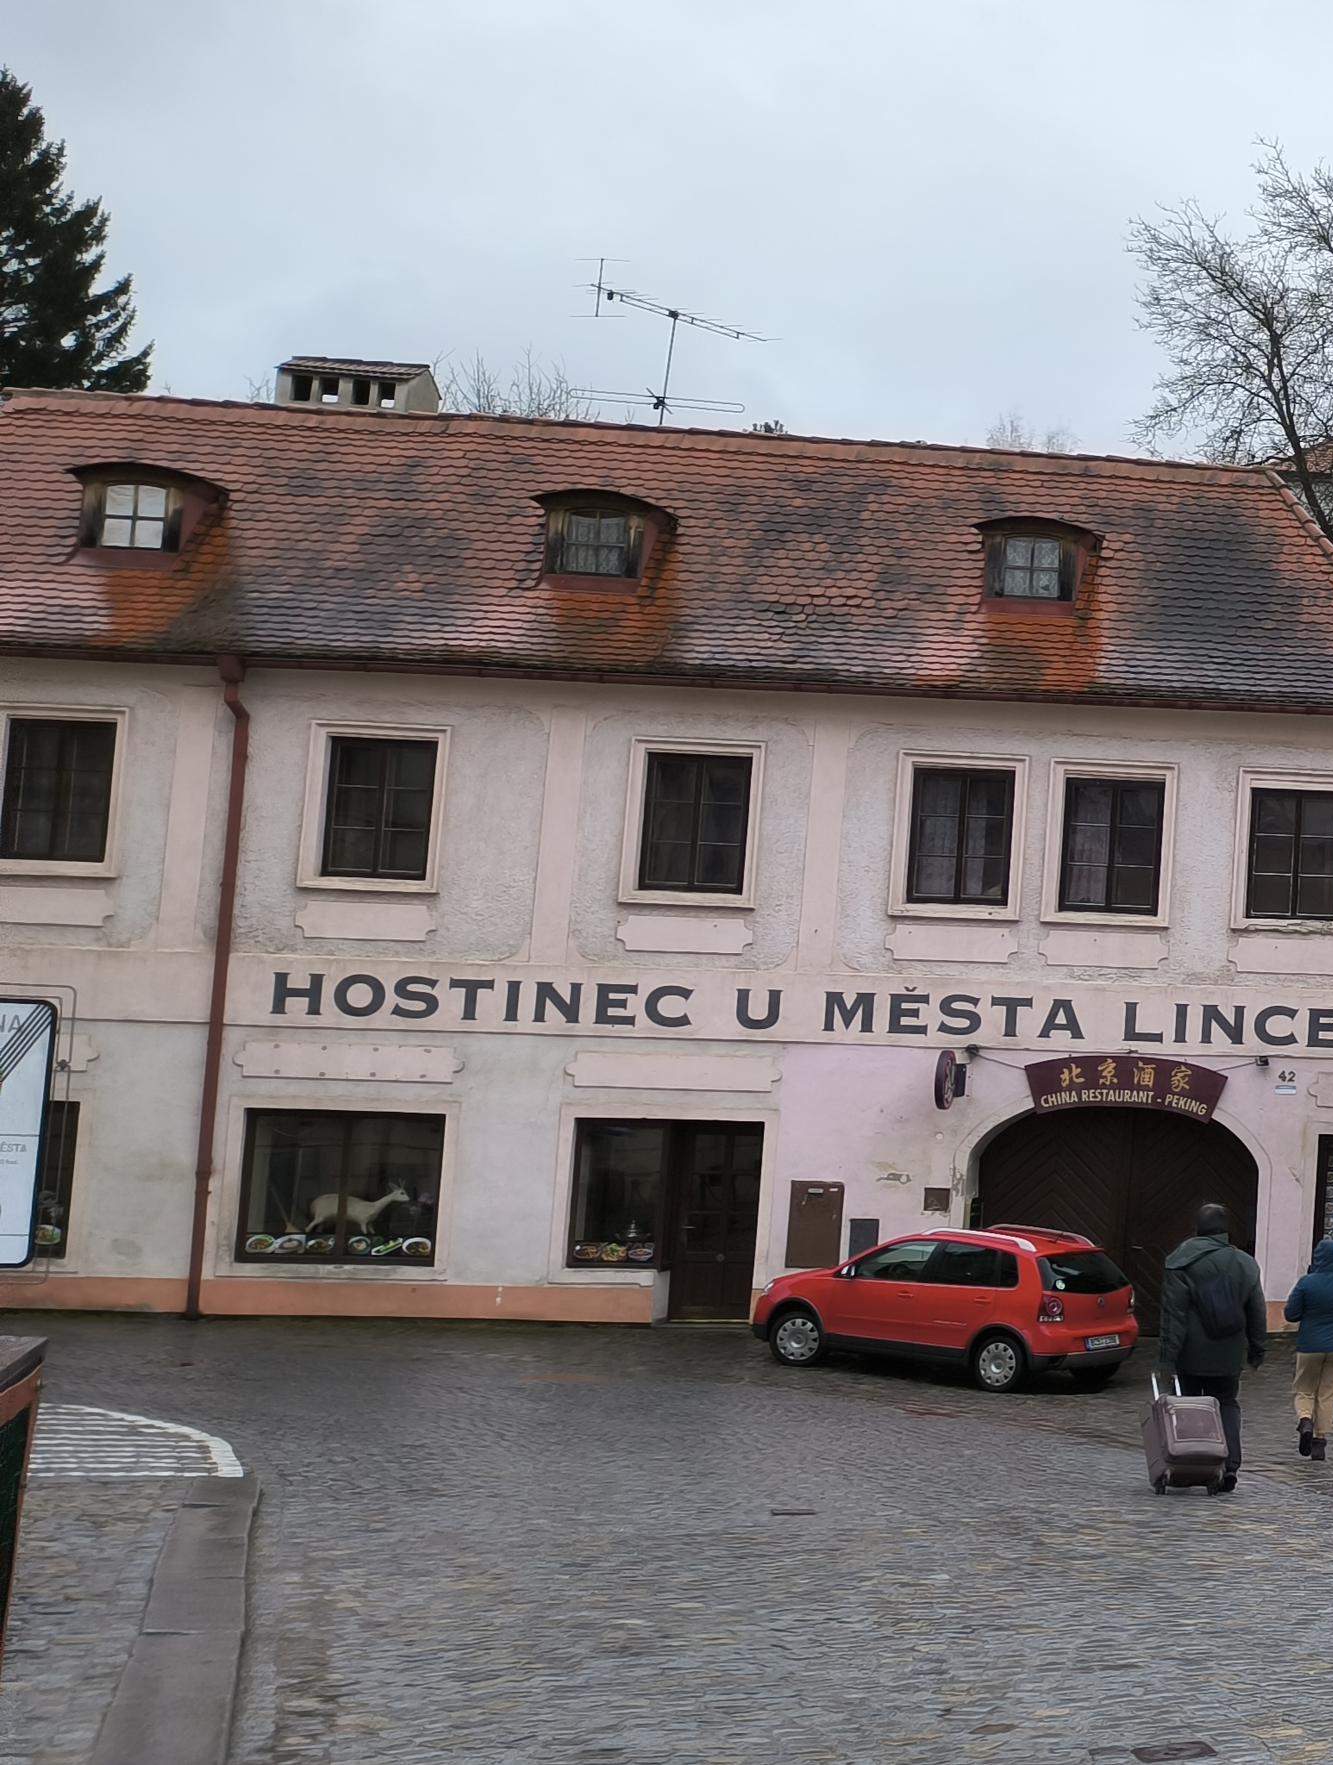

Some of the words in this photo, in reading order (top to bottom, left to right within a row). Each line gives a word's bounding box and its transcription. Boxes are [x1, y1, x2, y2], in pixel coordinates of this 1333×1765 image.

[271, 971, 694, 1028] HOSTINEC
[736, 988, 782, 1030] U
[823, 985, 1084, 1040] MĚSTA
[1059, 1057, 1193, 1092] 北京酒家
[1278, 1070, 1296, 1083] 42
[1041, 1089, 1078, 1108] CHINA
[1082, 1089, 1155, 1104] RESTAURANT
[1165, 1094, 1208, 1116] PEKING
